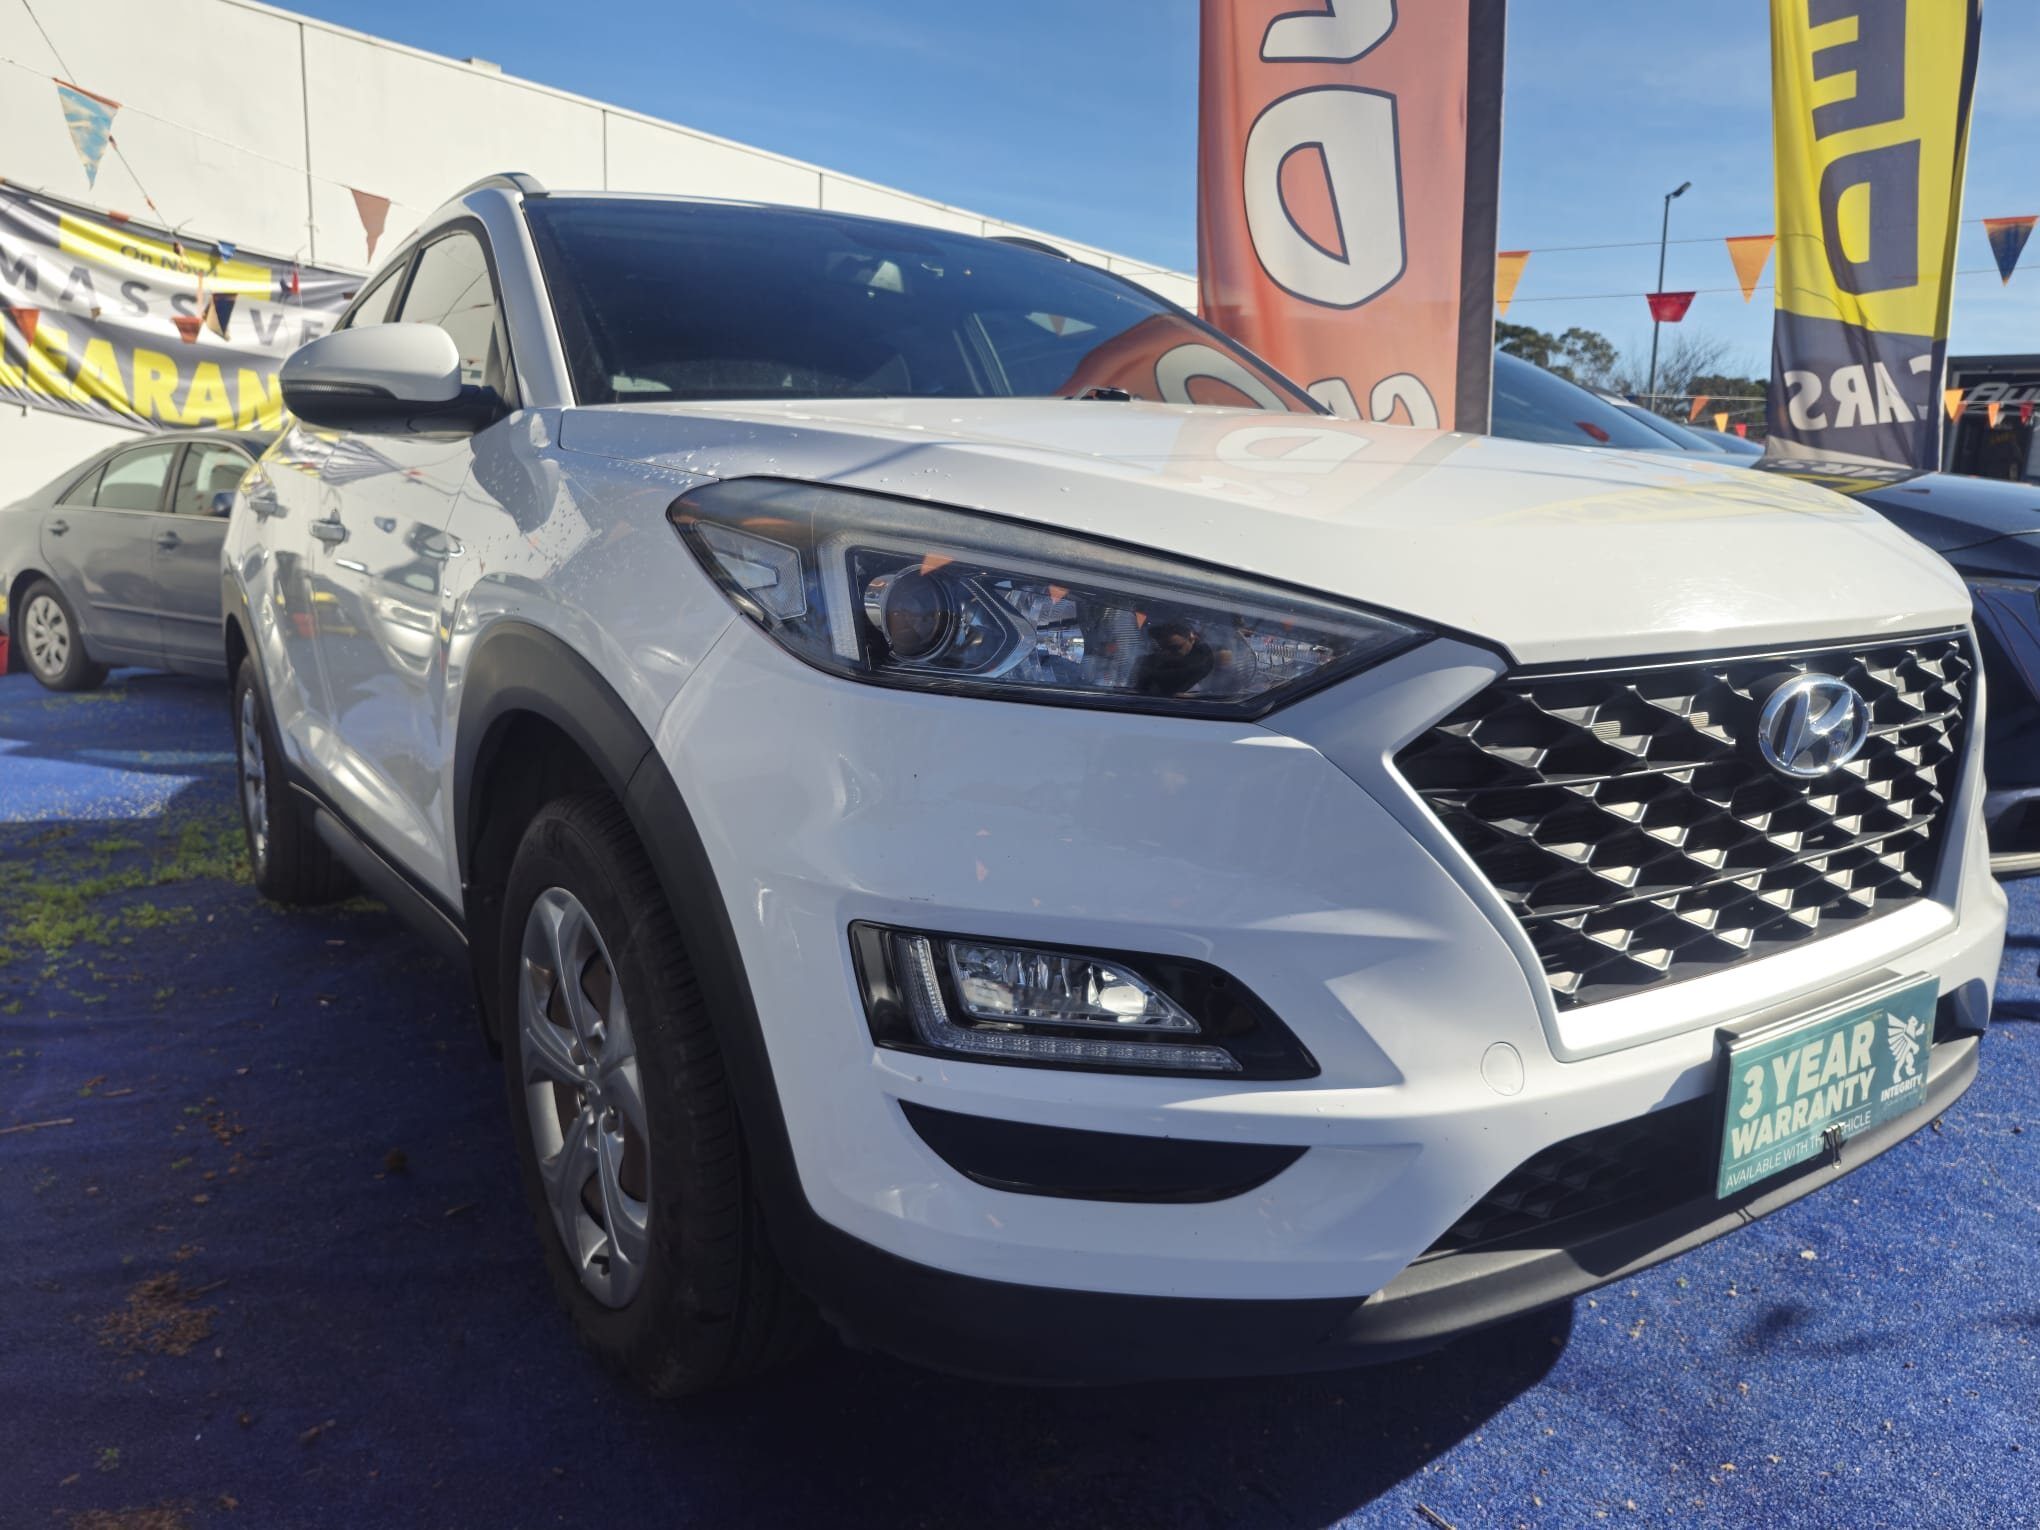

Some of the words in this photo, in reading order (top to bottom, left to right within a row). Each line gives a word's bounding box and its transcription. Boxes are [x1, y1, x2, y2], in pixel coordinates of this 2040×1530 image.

[0, 243, 324, 345] MASSVE
[120, 244, 152, 264] On
[1731, 1067, 1876, 1160] WARRANTY
[1738, 1064, 1765, 1120] 3
[1772, 1021, 1876, 1105] YEAR
[1880, 1072, 1923, 1102] INTEGRITY
[1725, 1153, 1782, 1191] AVAILABLE
[1783, 1141, 1809, 1161] WITH
[1840, 1110, 1872, 1134] HICLE
